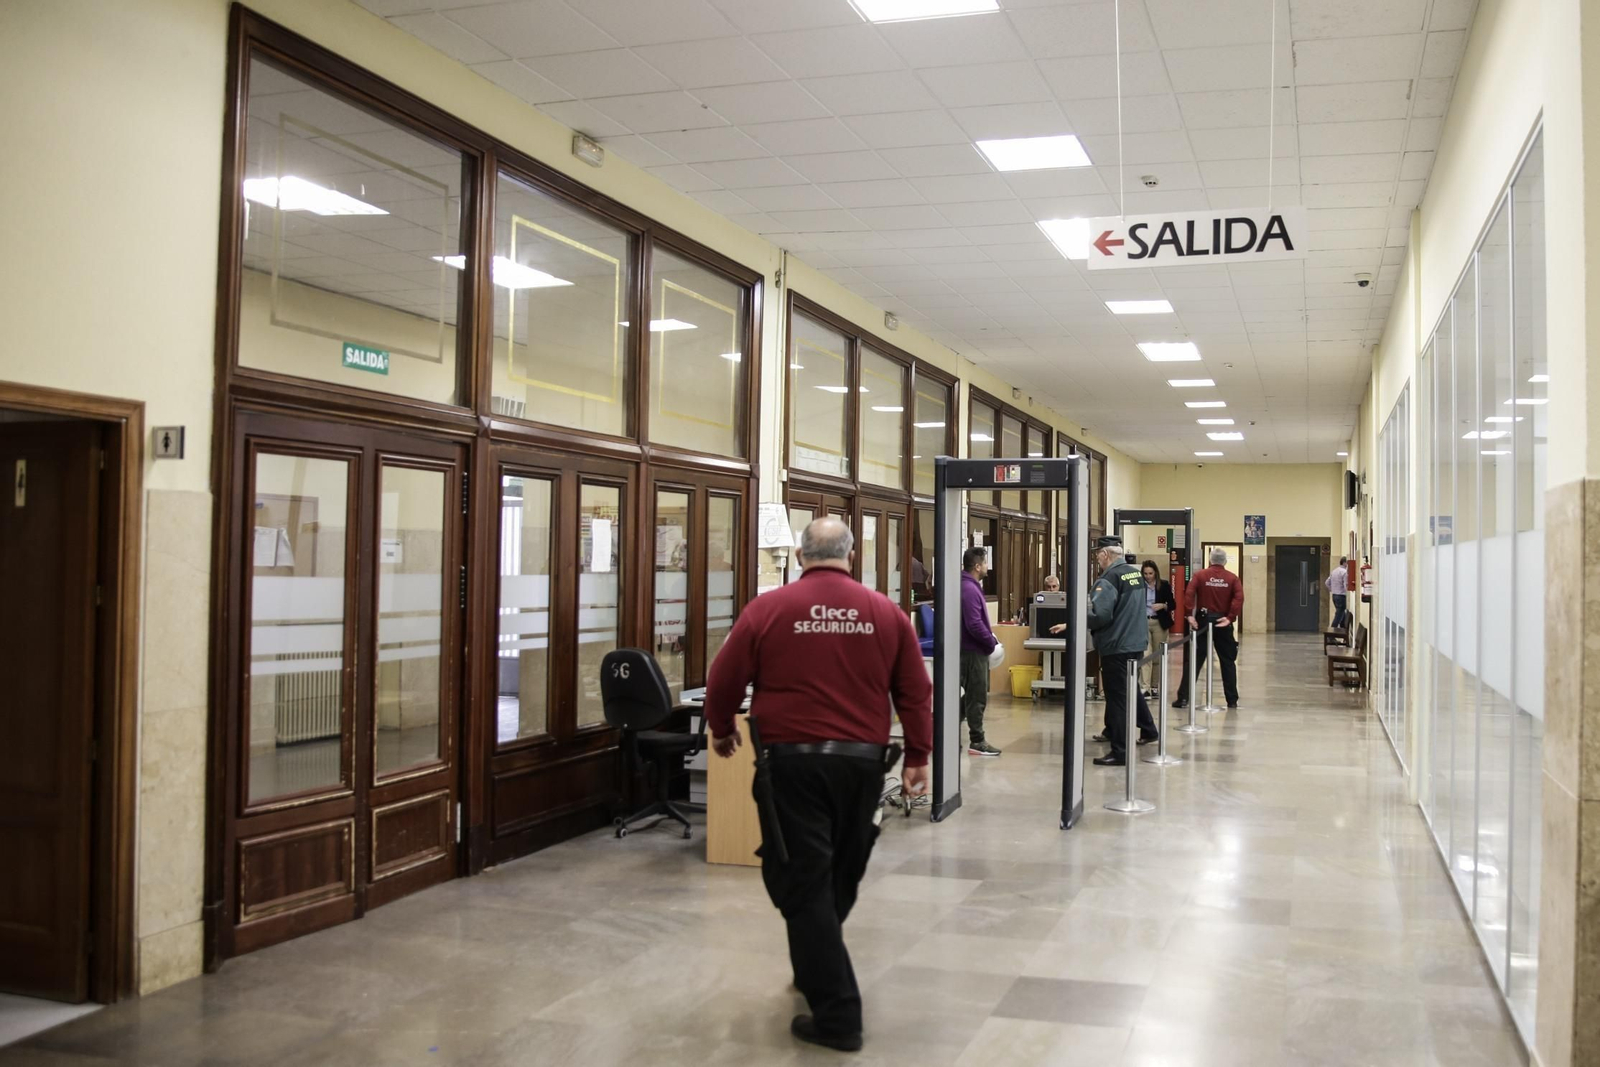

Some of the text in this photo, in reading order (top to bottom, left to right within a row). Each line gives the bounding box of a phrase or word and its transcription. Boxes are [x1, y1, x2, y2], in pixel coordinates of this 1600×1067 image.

[1128, 215, 1294, 259] SALIDA
[346, 347, 384, 370] SALIDA
[810, 605, 859, 621] Clece
[794, 621, 875, 635] SEGURIDAD
